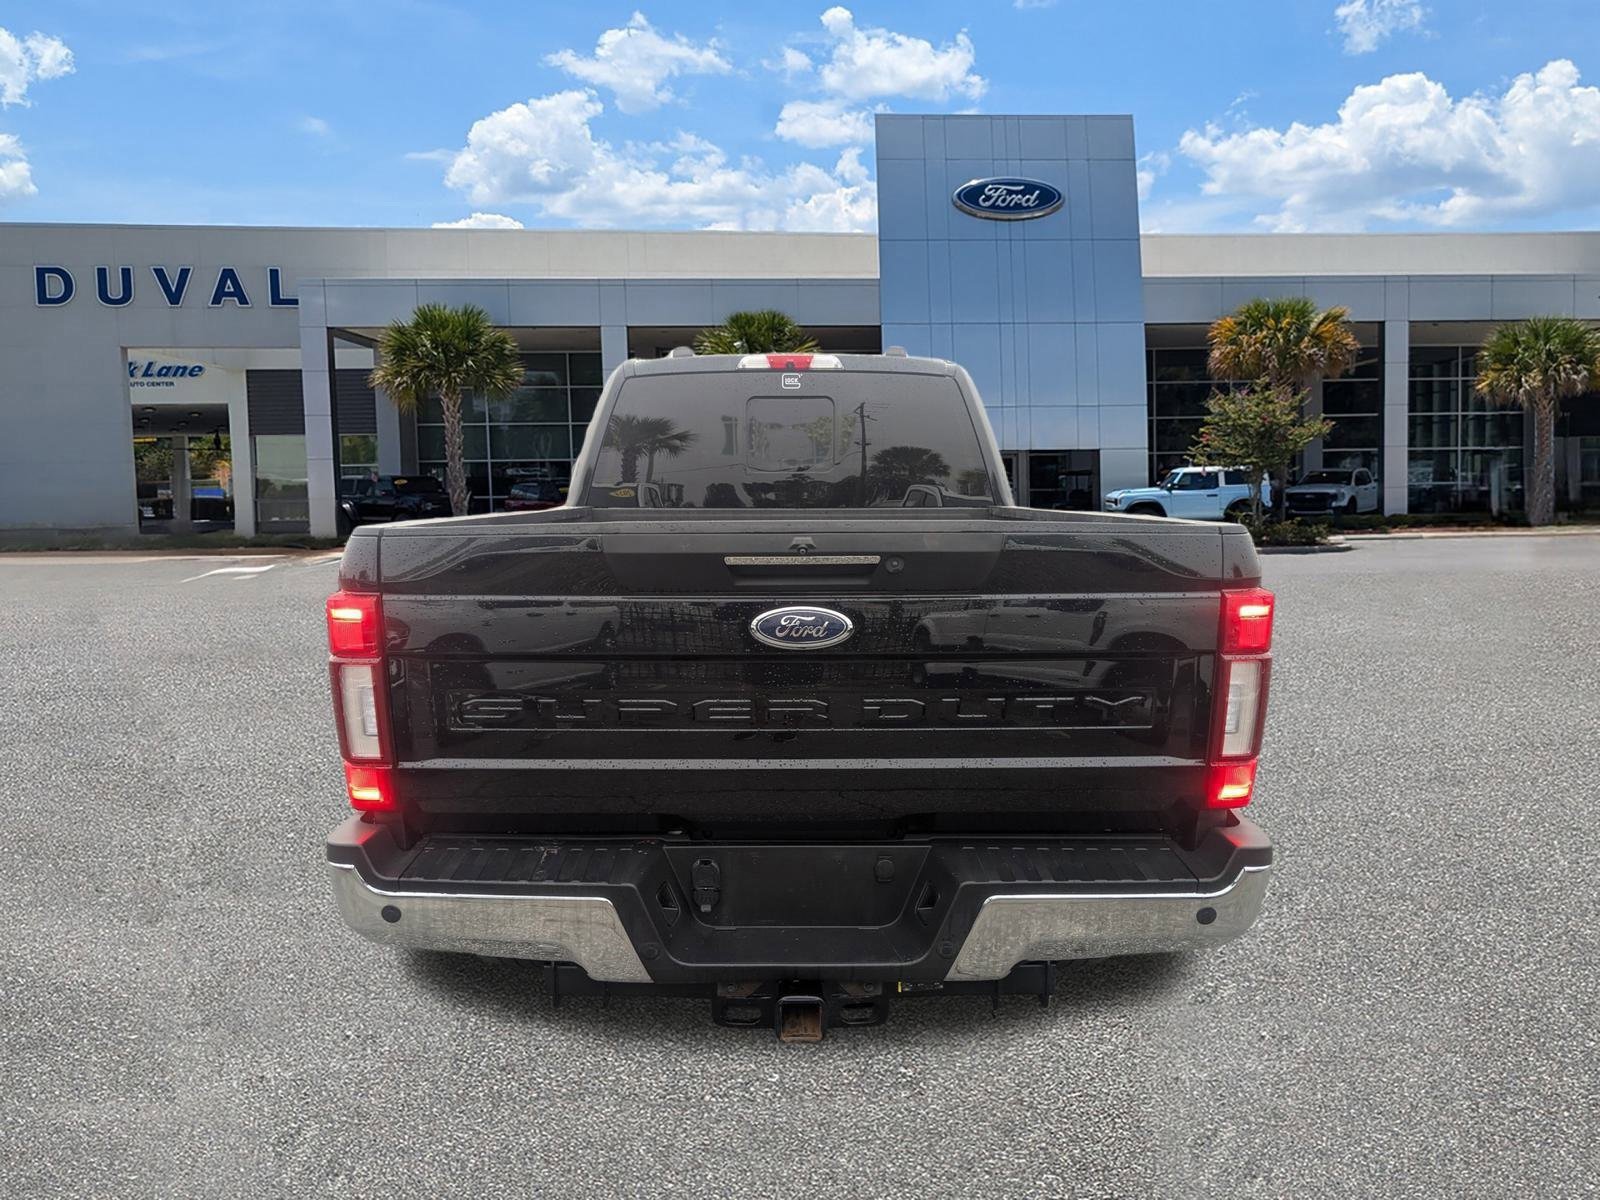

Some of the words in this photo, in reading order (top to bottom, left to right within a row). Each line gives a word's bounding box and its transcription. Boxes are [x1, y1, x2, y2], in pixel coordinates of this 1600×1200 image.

[979, 184, 1040, 207] Ford
[33, 265, 299, 308] DUVAL
[141, 361, 205, 378] Lane
[775, 615, 829, 638] Ford
[460, 697, 828, 727] SUPER
[862, 694, 1147, 725] DUTY
